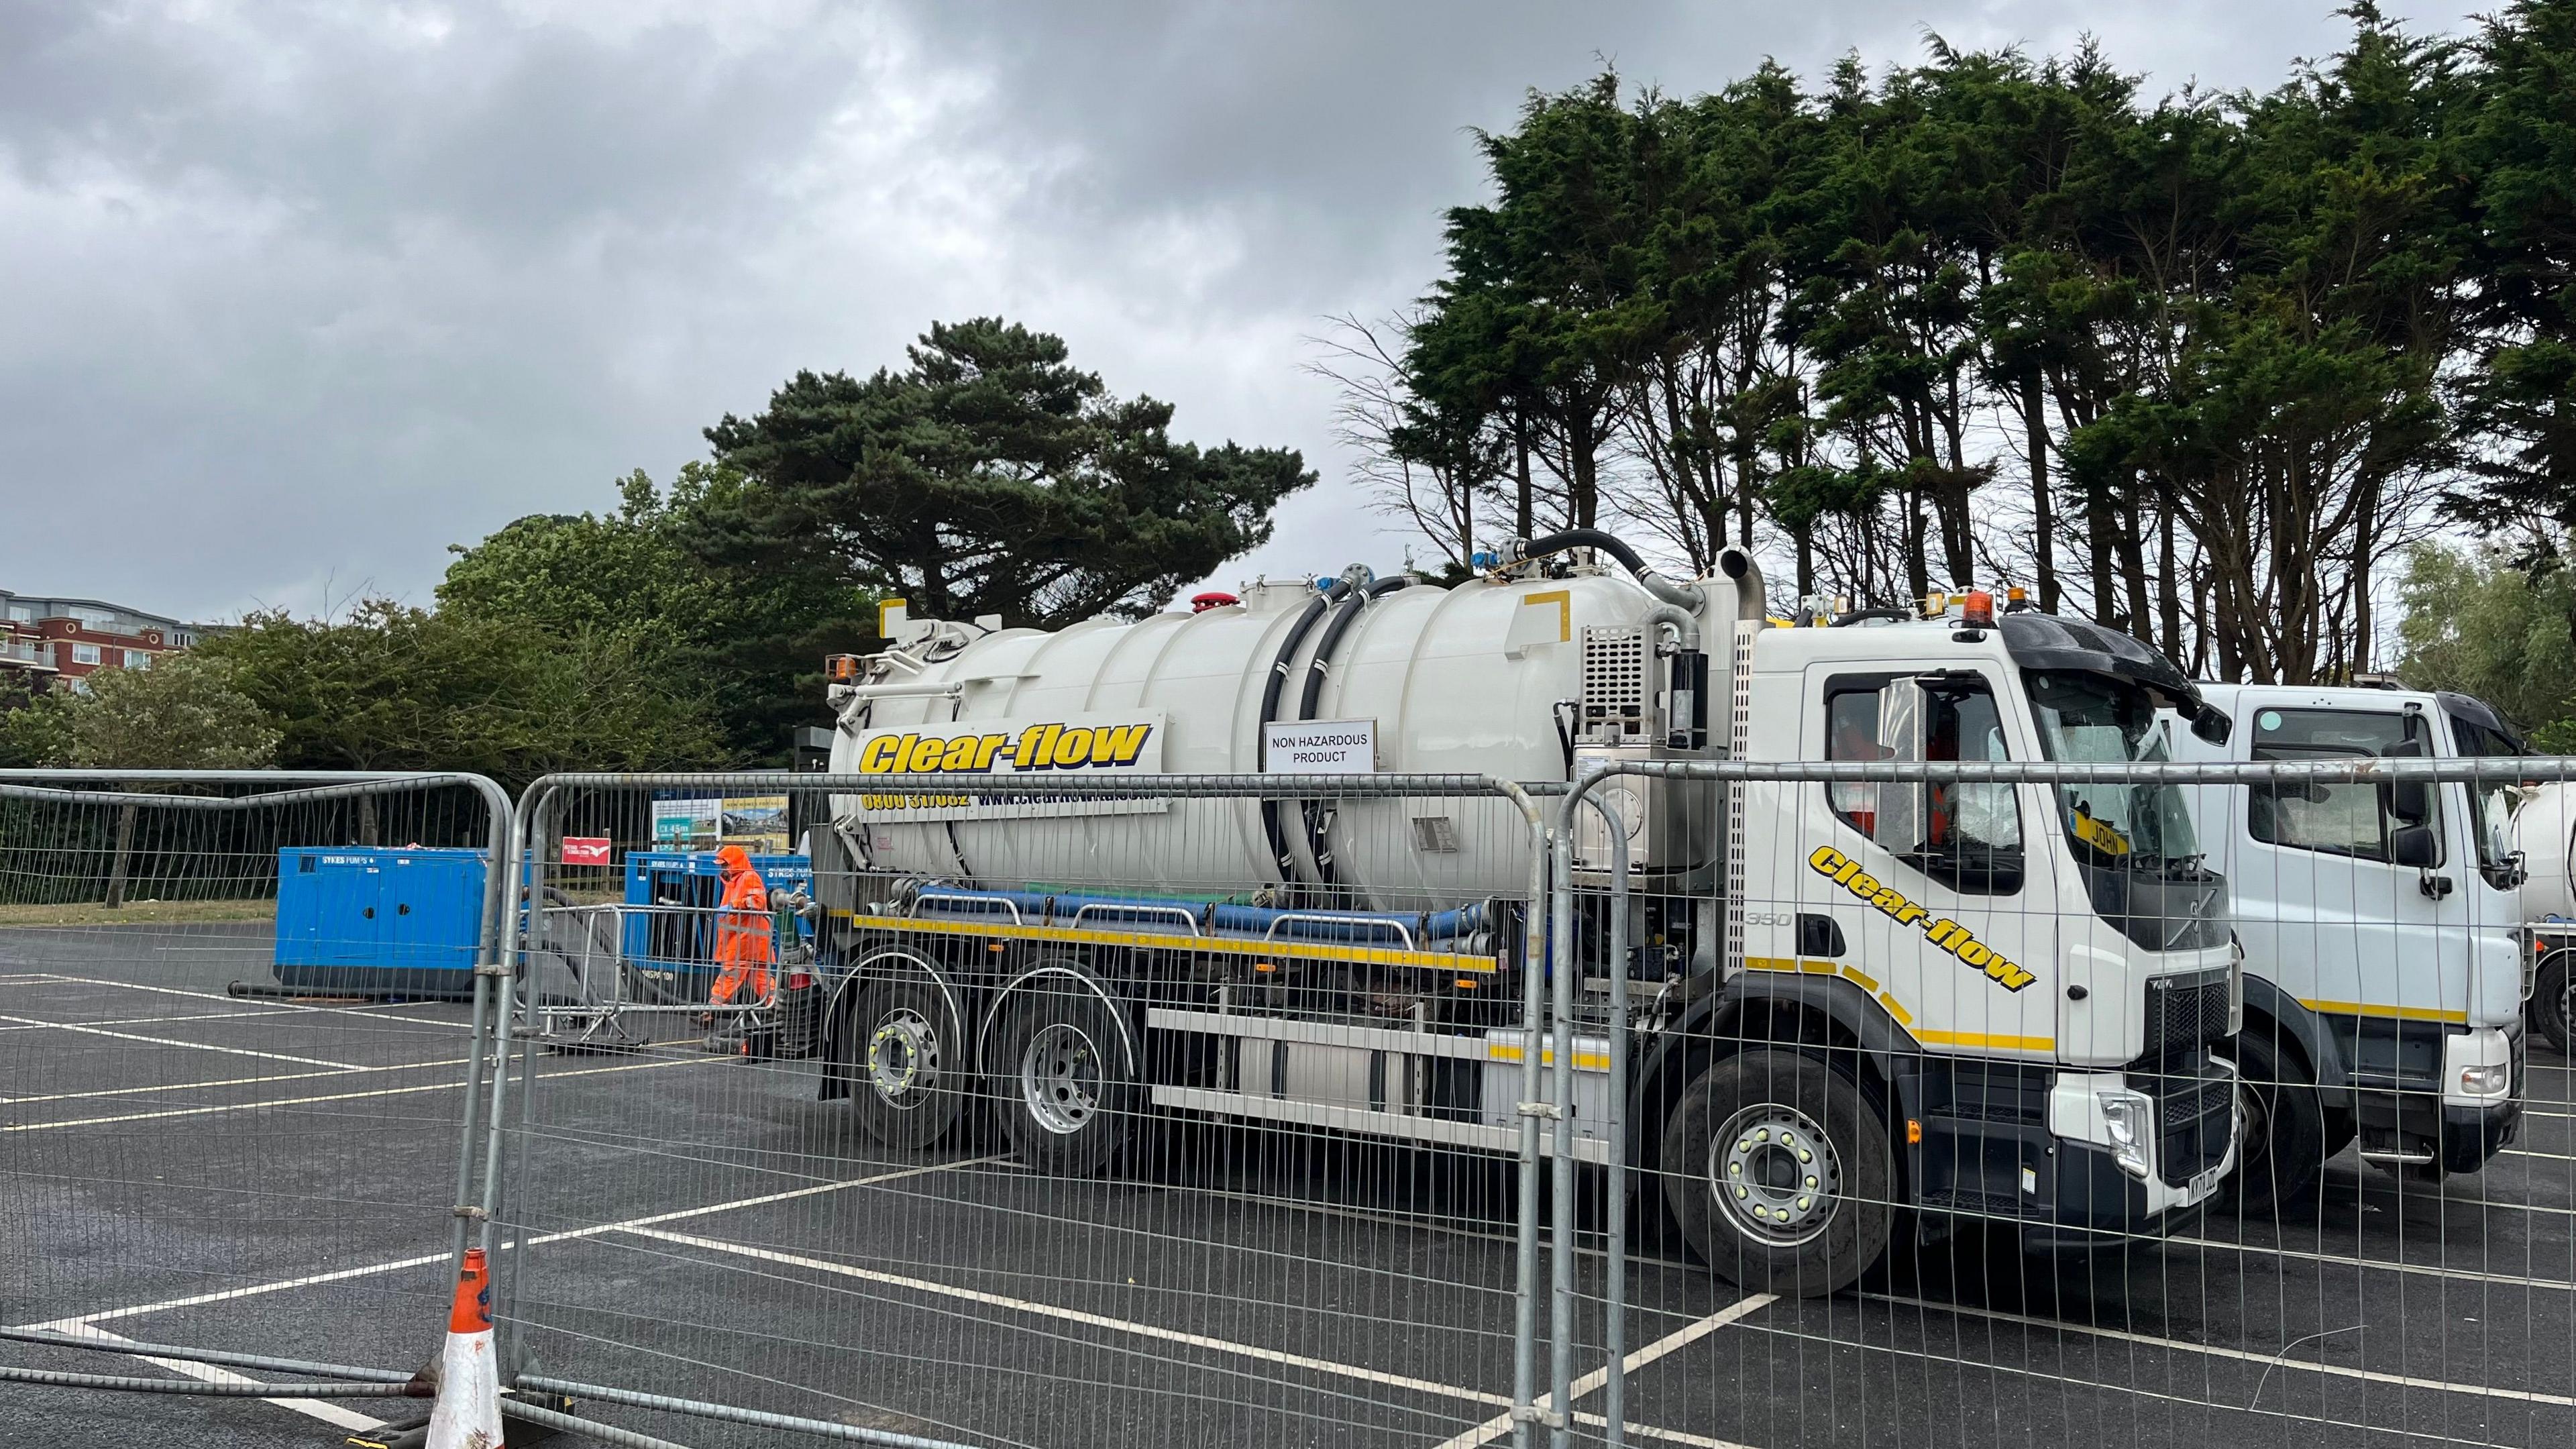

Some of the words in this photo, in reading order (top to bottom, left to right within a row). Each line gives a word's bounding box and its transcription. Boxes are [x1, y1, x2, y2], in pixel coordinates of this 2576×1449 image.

[859, 722, 1154, 773] Clear-flow
[1272, 737, 1295, 748] NON
[1299, 734, 1368, 748] HAZARDOUS
[1293, 751, 1346, 763] PRODUCT
[2092, 824, 2118, 855] JOHN
[1745, 912, 1792, 926] 350
[1808, 845, 2037, 993] Clear-flow
